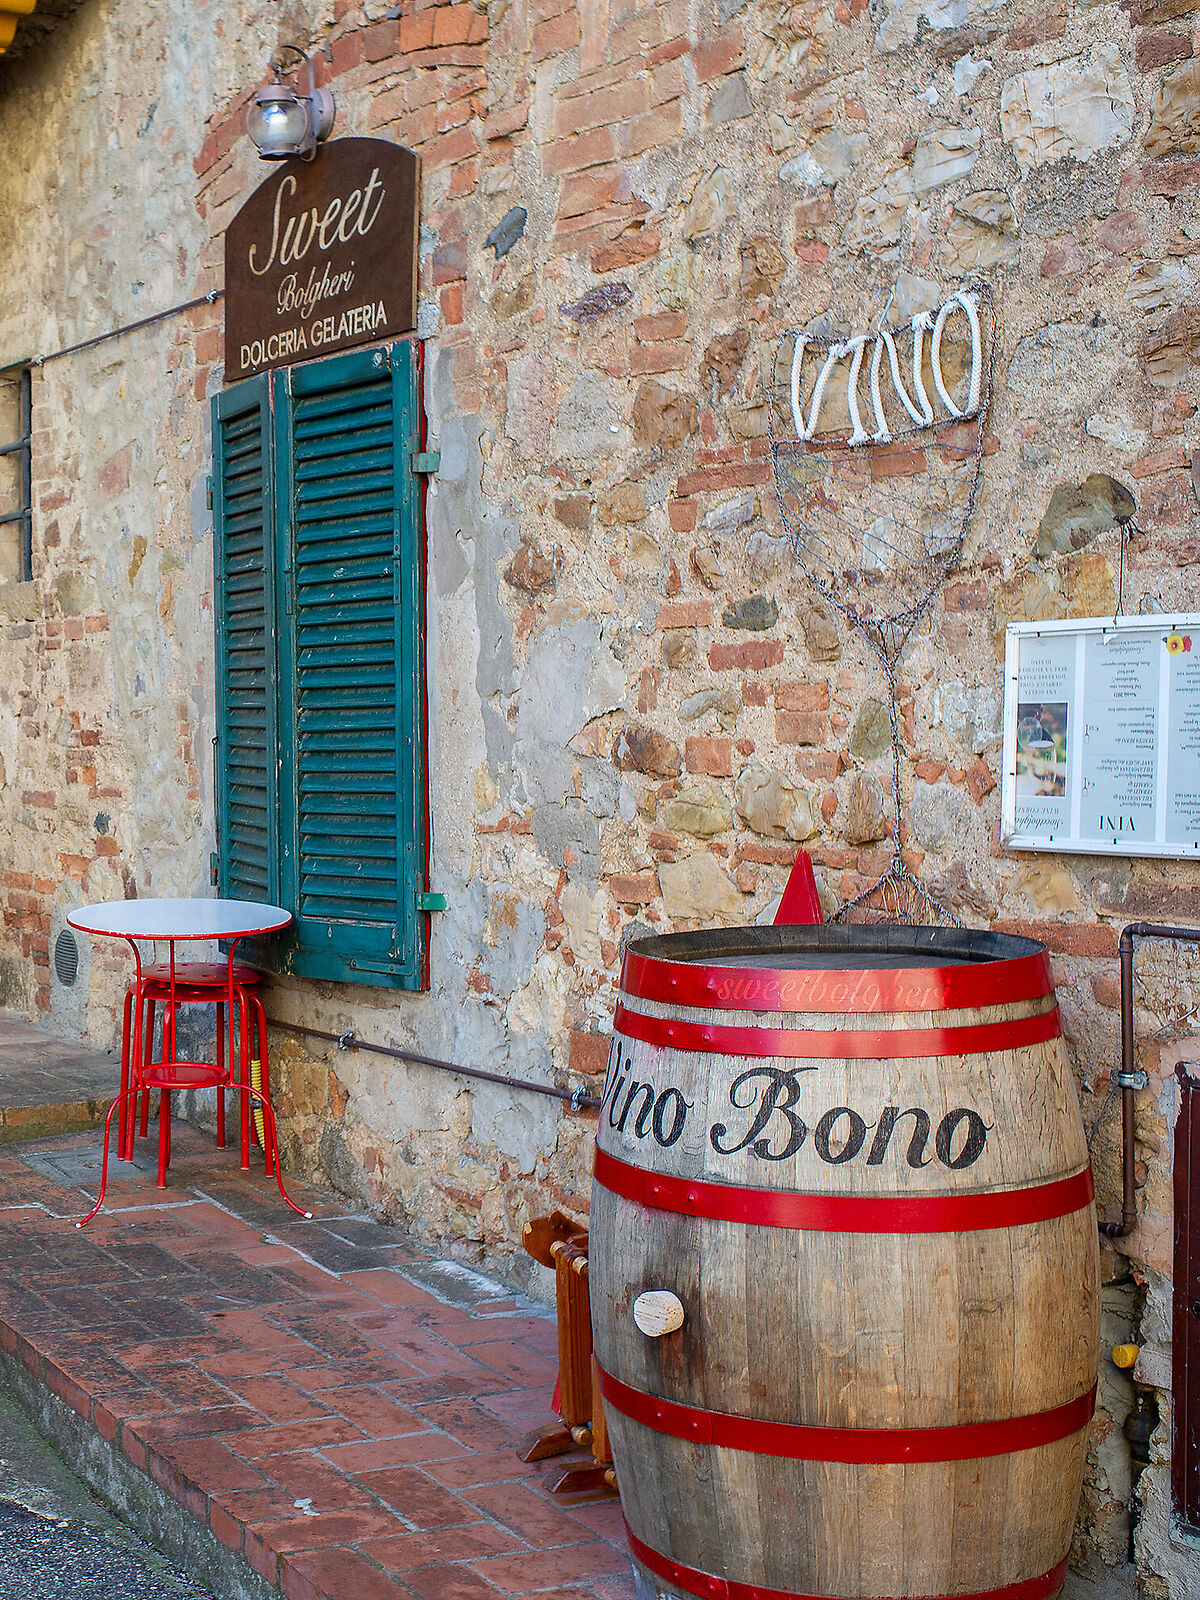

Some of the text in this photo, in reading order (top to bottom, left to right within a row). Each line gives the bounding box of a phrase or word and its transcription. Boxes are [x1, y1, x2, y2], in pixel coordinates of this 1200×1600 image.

[249, 168, 386, 276] Sweet
[276, 260, 355, 319] Bolgheri
[240, 300, 388, 369] DOLCERIA GELATERIA
[1099, 815, 1136, 831] VINI
[717, 969, 951, 1012] sweetbolgheri
[601, 1037, 994, 1170] Vino Bono
